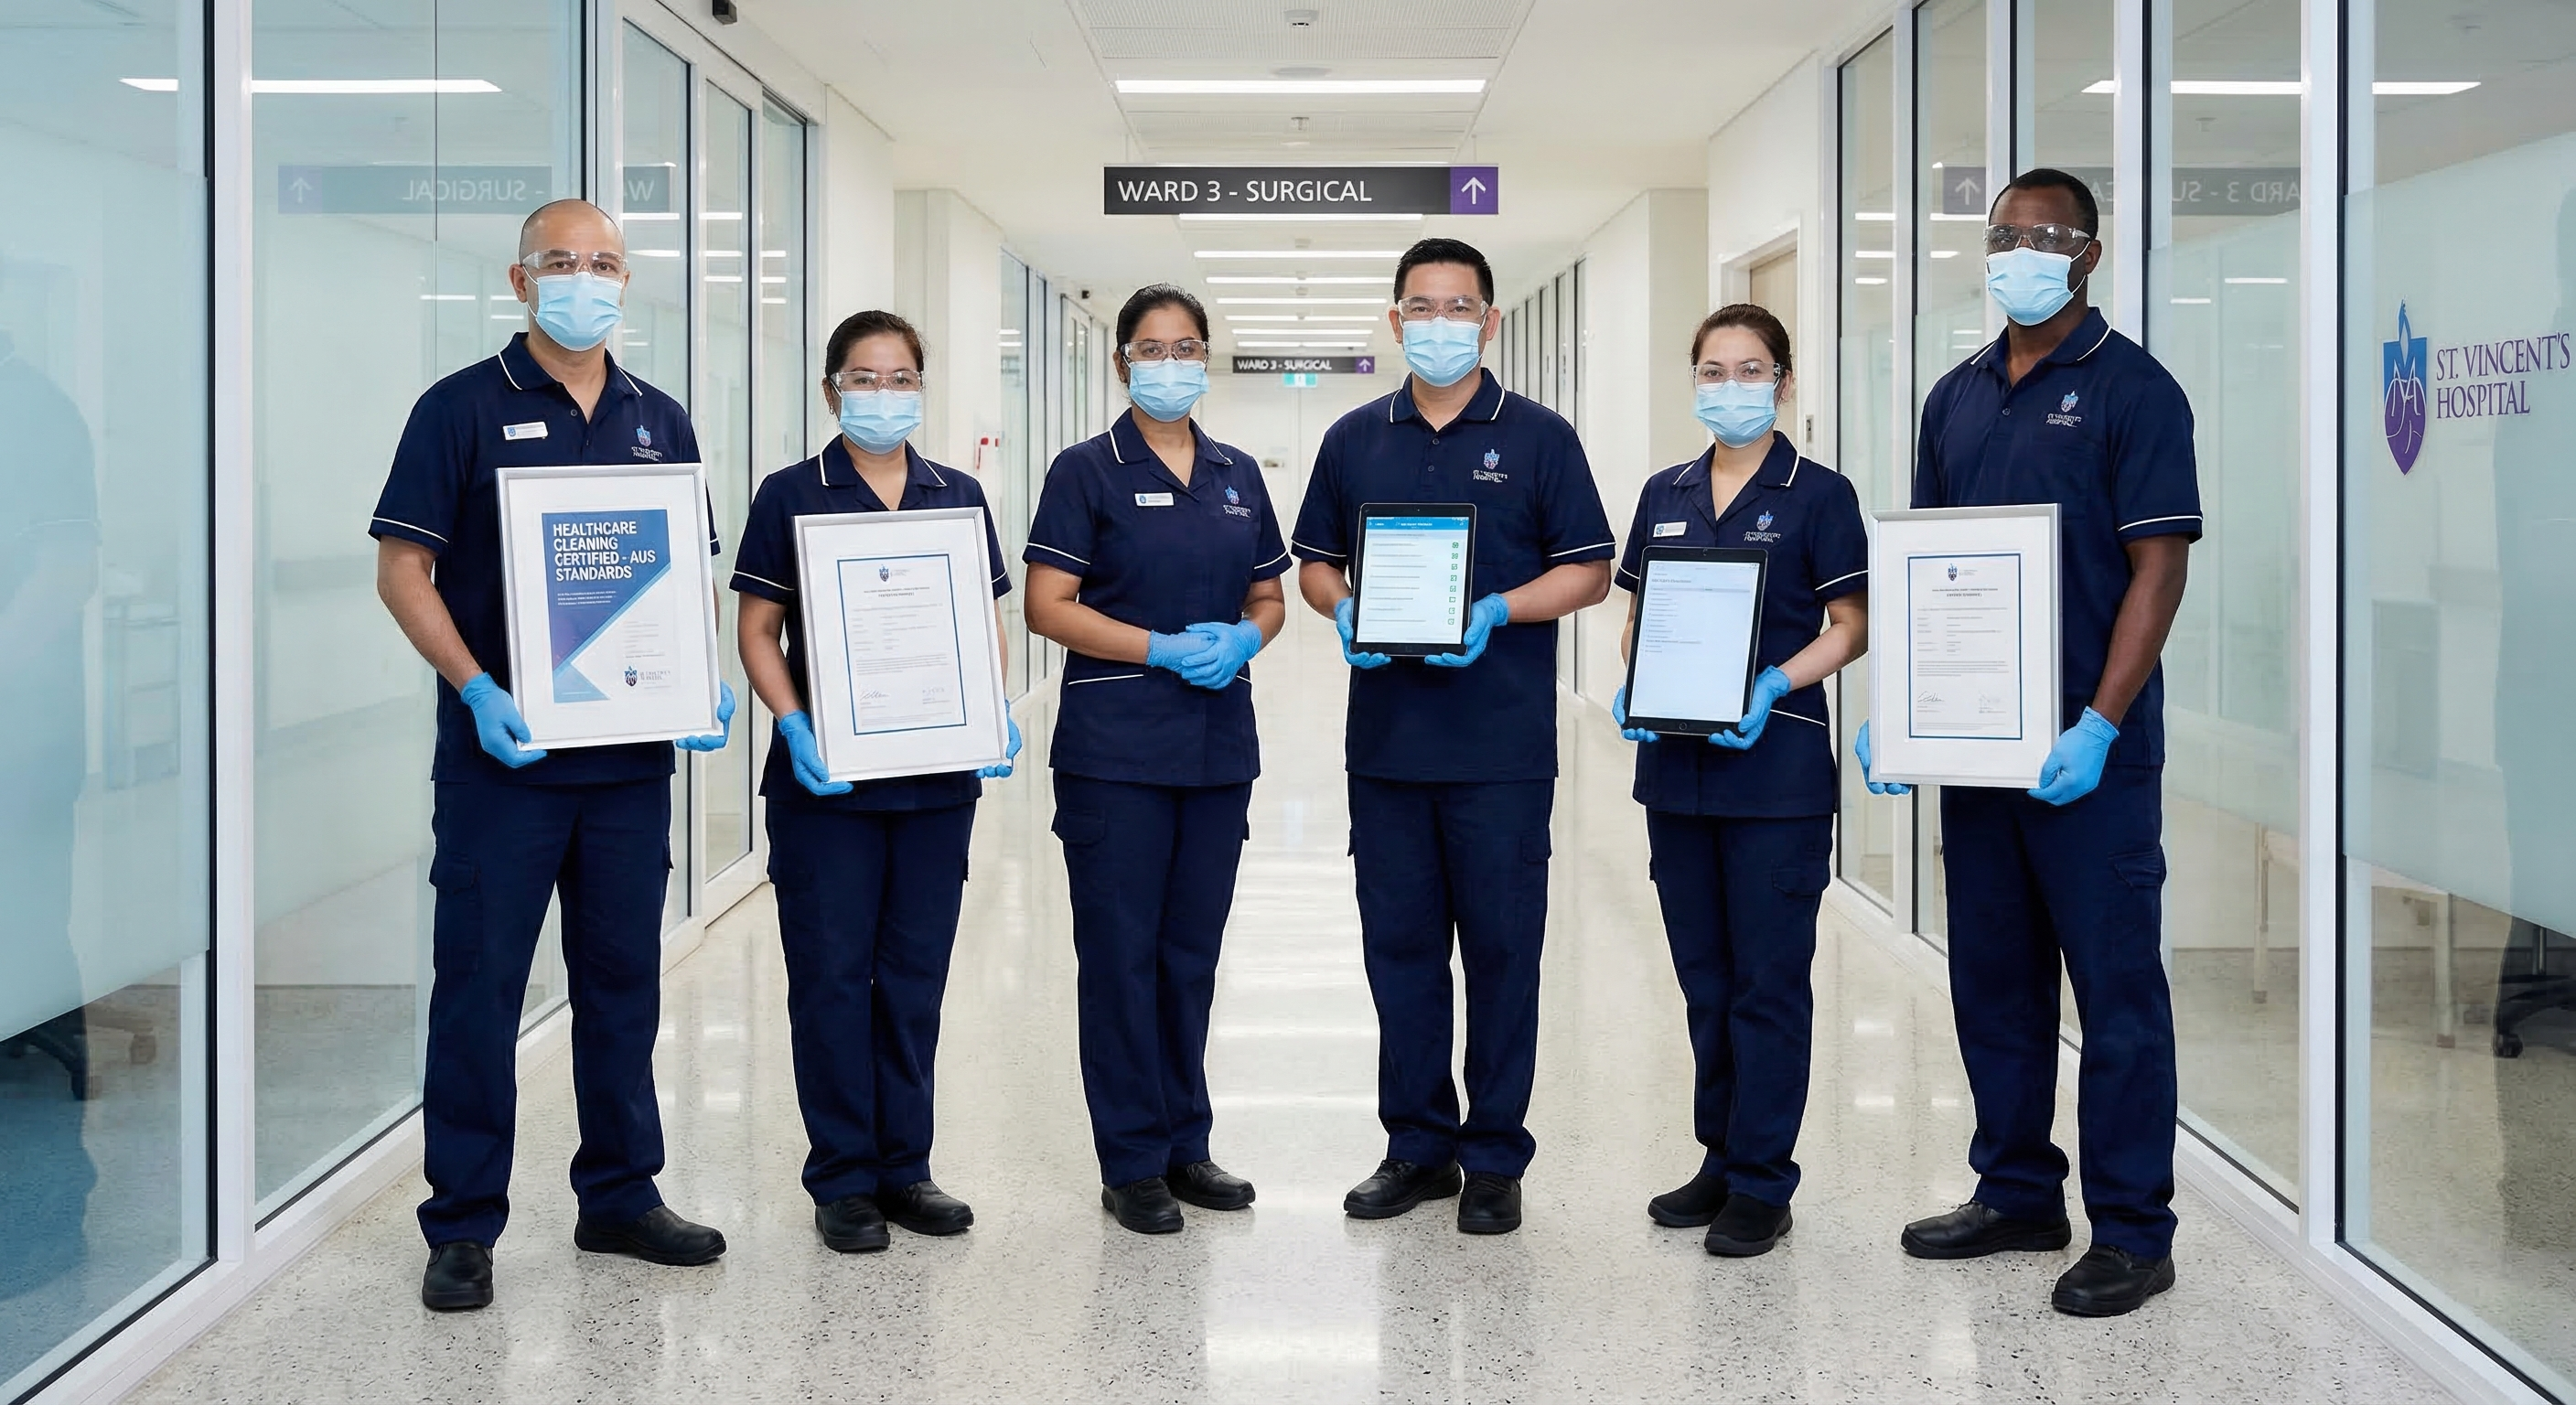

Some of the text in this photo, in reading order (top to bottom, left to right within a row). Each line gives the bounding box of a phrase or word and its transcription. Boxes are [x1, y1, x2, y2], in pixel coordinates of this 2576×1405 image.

[1117, 180, 1198, 202] WARD
[1207, 180, 1221, 202] 3
[1246, 180, 1373, 202] SURGICAL
[2436, 332, 2571, 381] ST. VINCENT'S
[2436, 381, 2531, 419] HOSPITAL
[553, 521, 638, 537] HEALTHCARE
[553, 536, 618, 552] CLEANING
[554, 551, 619, 567] CERTIFIED
[629, 550, 656, 564] AUS
[555, 565, 633, 582] STANDARDS
